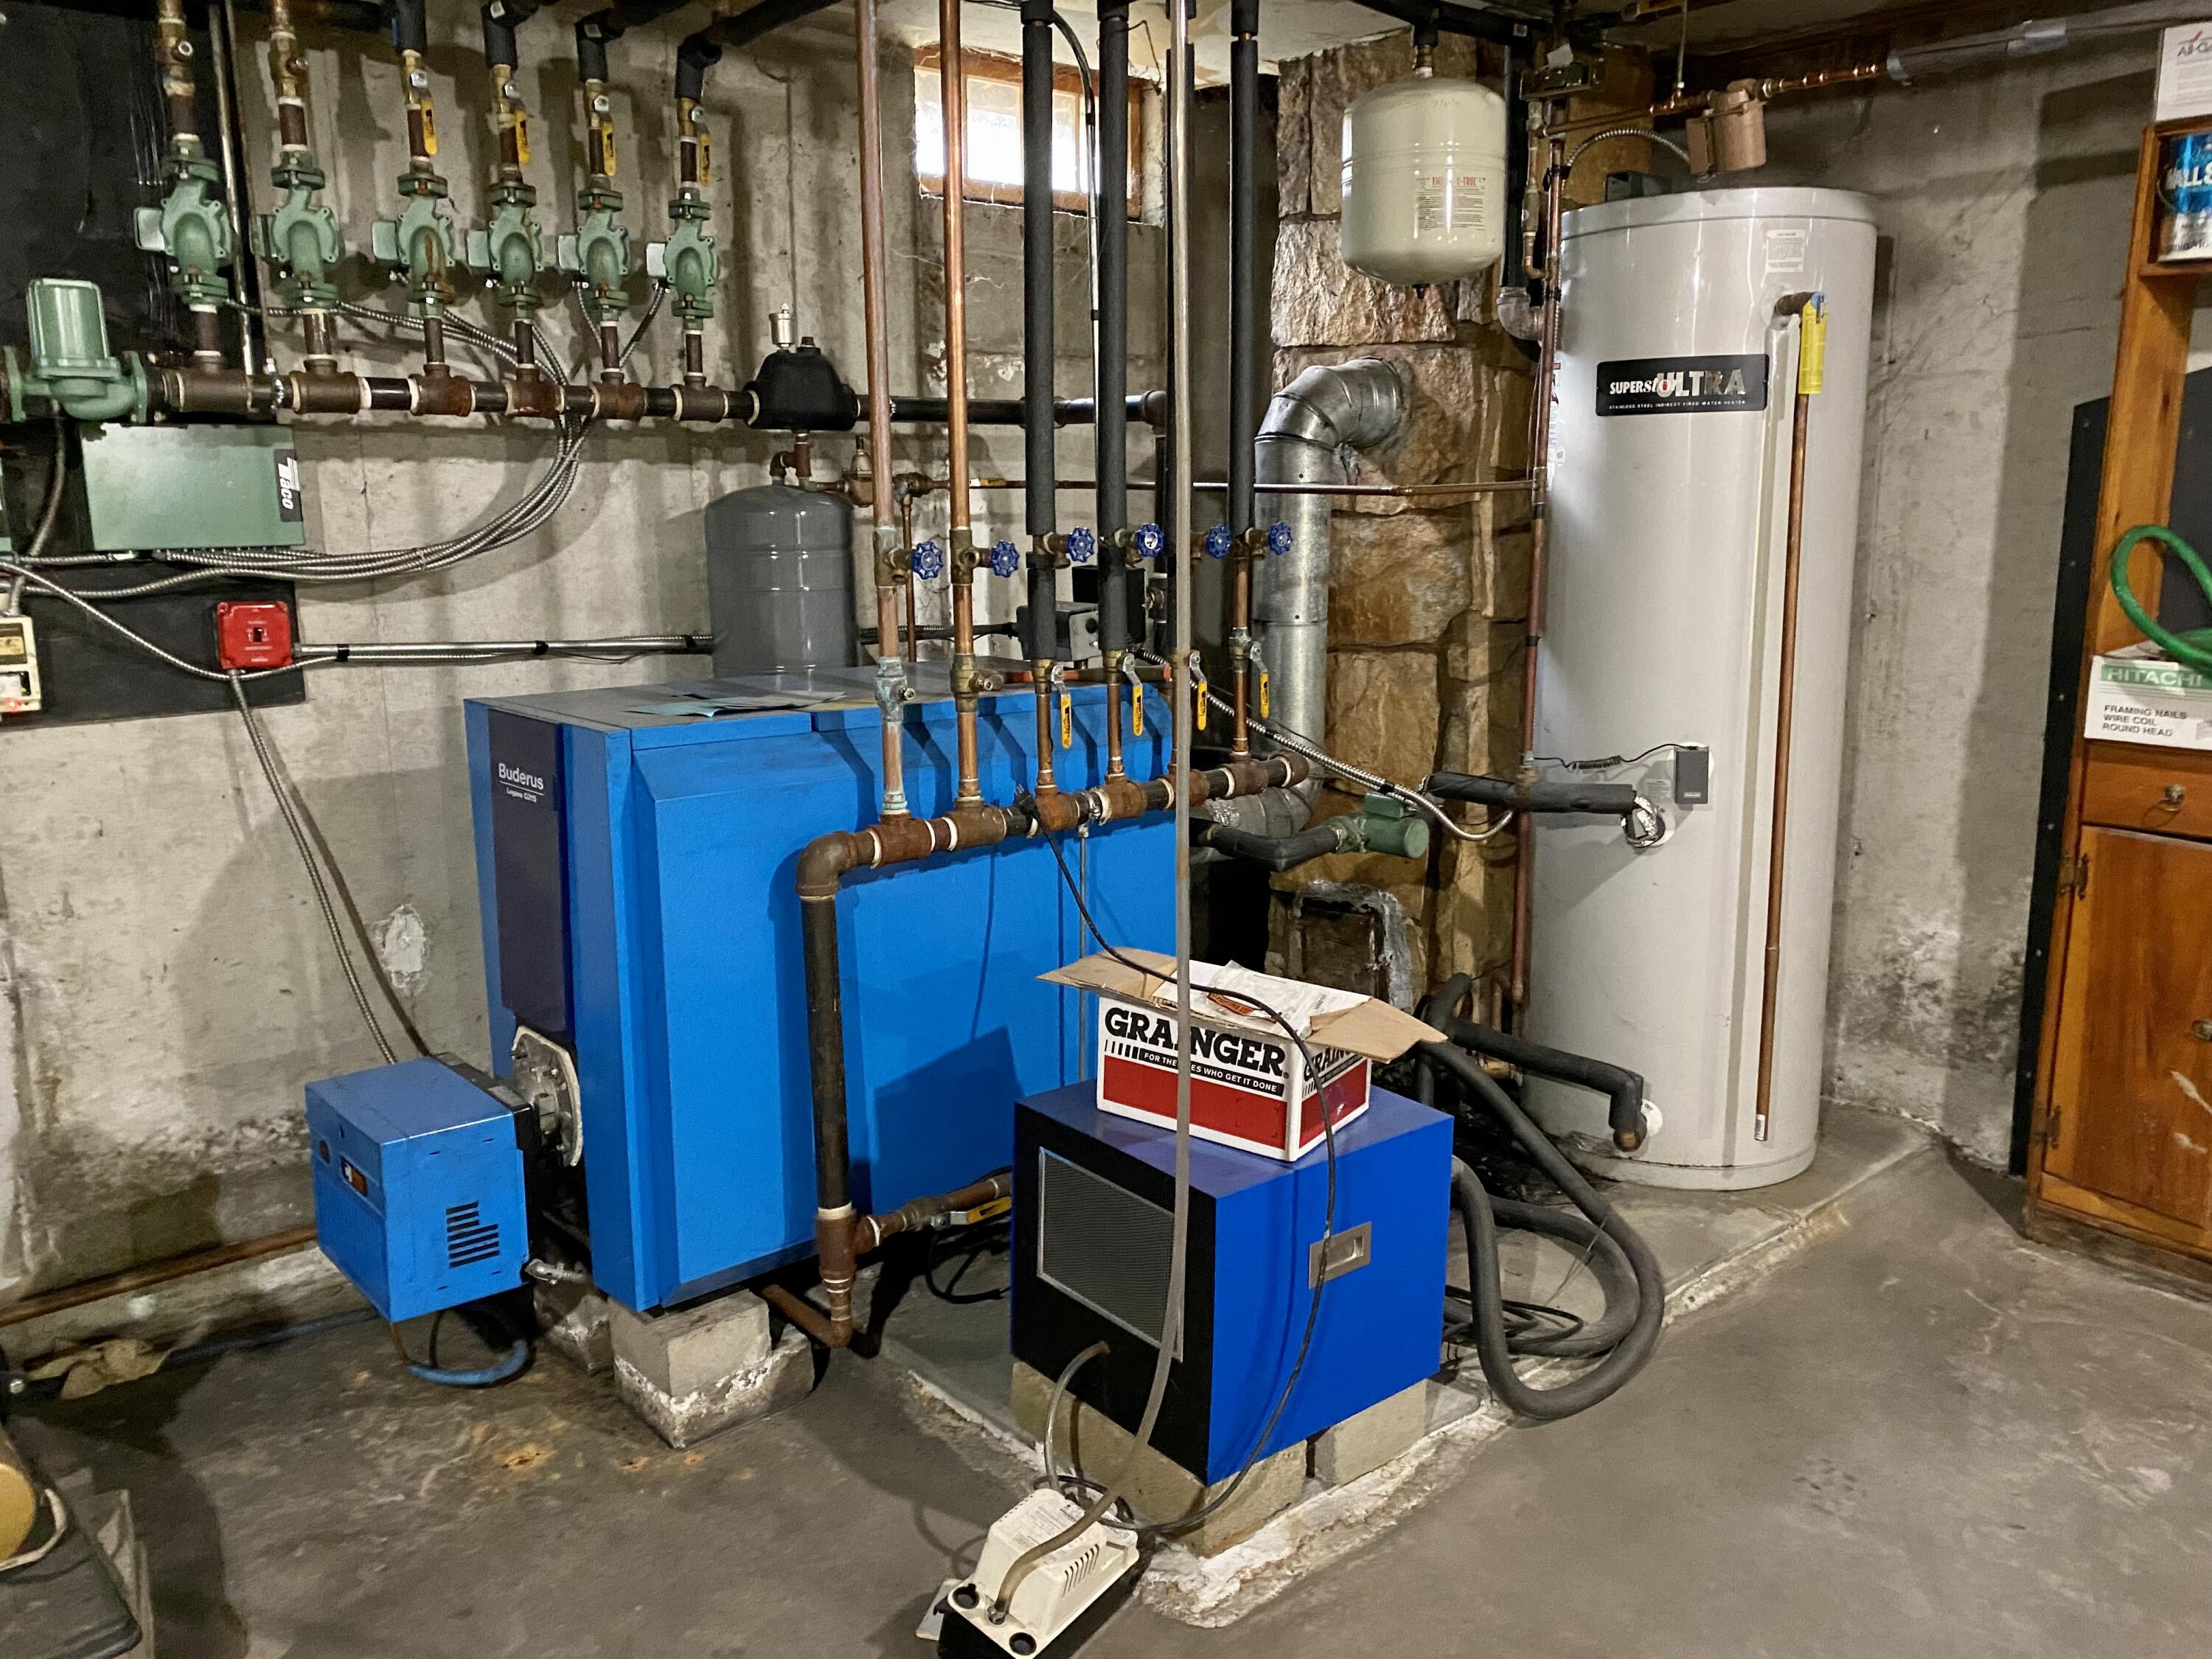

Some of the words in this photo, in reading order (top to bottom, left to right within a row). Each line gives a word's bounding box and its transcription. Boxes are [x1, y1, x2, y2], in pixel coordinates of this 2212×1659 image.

[1657, 369, 1746, 398] ULTRA
[278, 457, 300, 509] Taco
[2107, 667, 2203, 686] HITACHI
[2104, 705, 2152, 716] FRAMING
[2154, 709, 2187, 720] NAILS
[2104, 714, 2129, 723] WIRE
[2133, 717, 2157, 726] COIL
[2103, 723, 2140, 733] ROUND
[2143, 727, 2173, 737] HEAD
[498, 762, 544, 790] Buderus
[1105, 1007, 1286, 1077] GRANGER
[1144, 1053, 1161, 1062] FOR
[1162, 1057, 1178, 1067] THE
[1204, 1068, 1223, 1078] WHO
[1225, 1073, 1242, 1083] GET
[1243, 1077, 1251, 1085] IT
[1253, 1080, 1277, 1093] DONE
